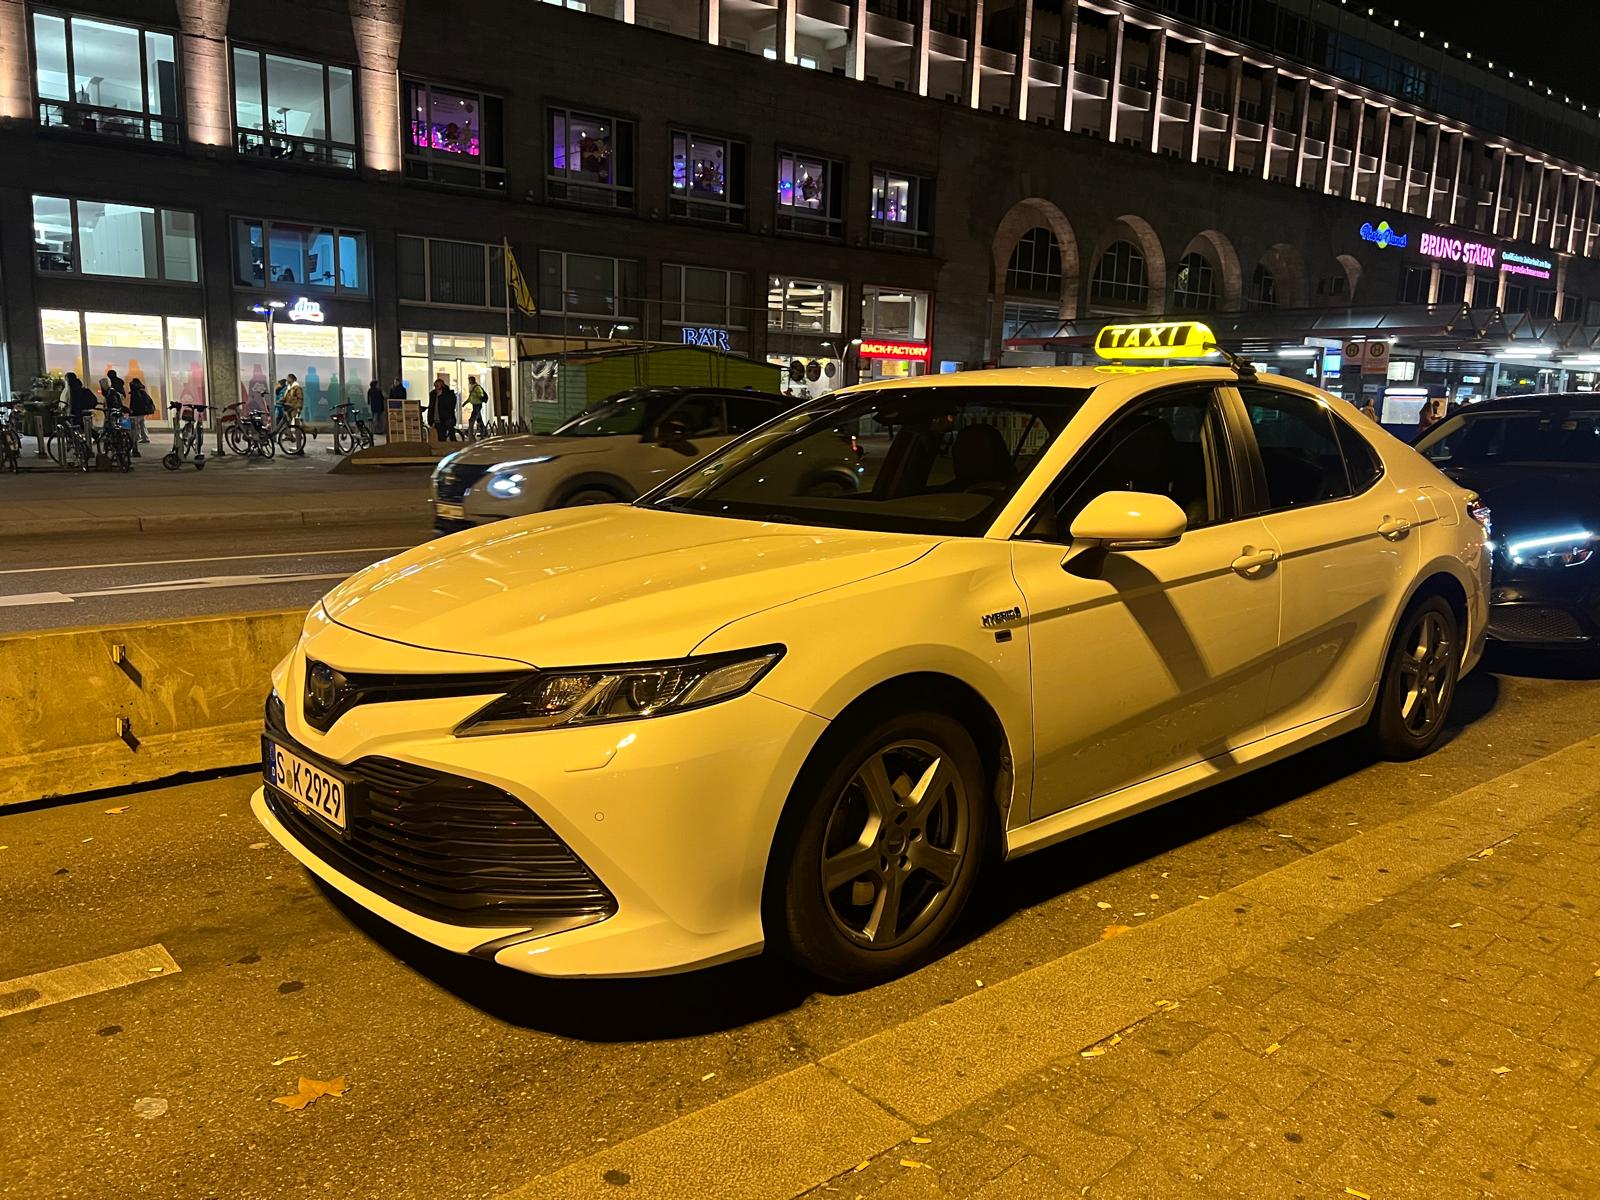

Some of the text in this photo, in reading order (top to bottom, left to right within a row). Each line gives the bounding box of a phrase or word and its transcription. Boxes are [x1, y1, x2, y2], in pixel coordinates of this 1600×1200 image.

[1419, 232, 1496, 268] BRUNO STÄRK
[295, 297, 319, 313] dm
[682, 327, 731, 350] BÄR
[1110, 326, 1179, 347] TAXI
[276, 751, 285, 784] S
[292, 759, 303, 796] K
[304, 767, 341, 820] 2929
